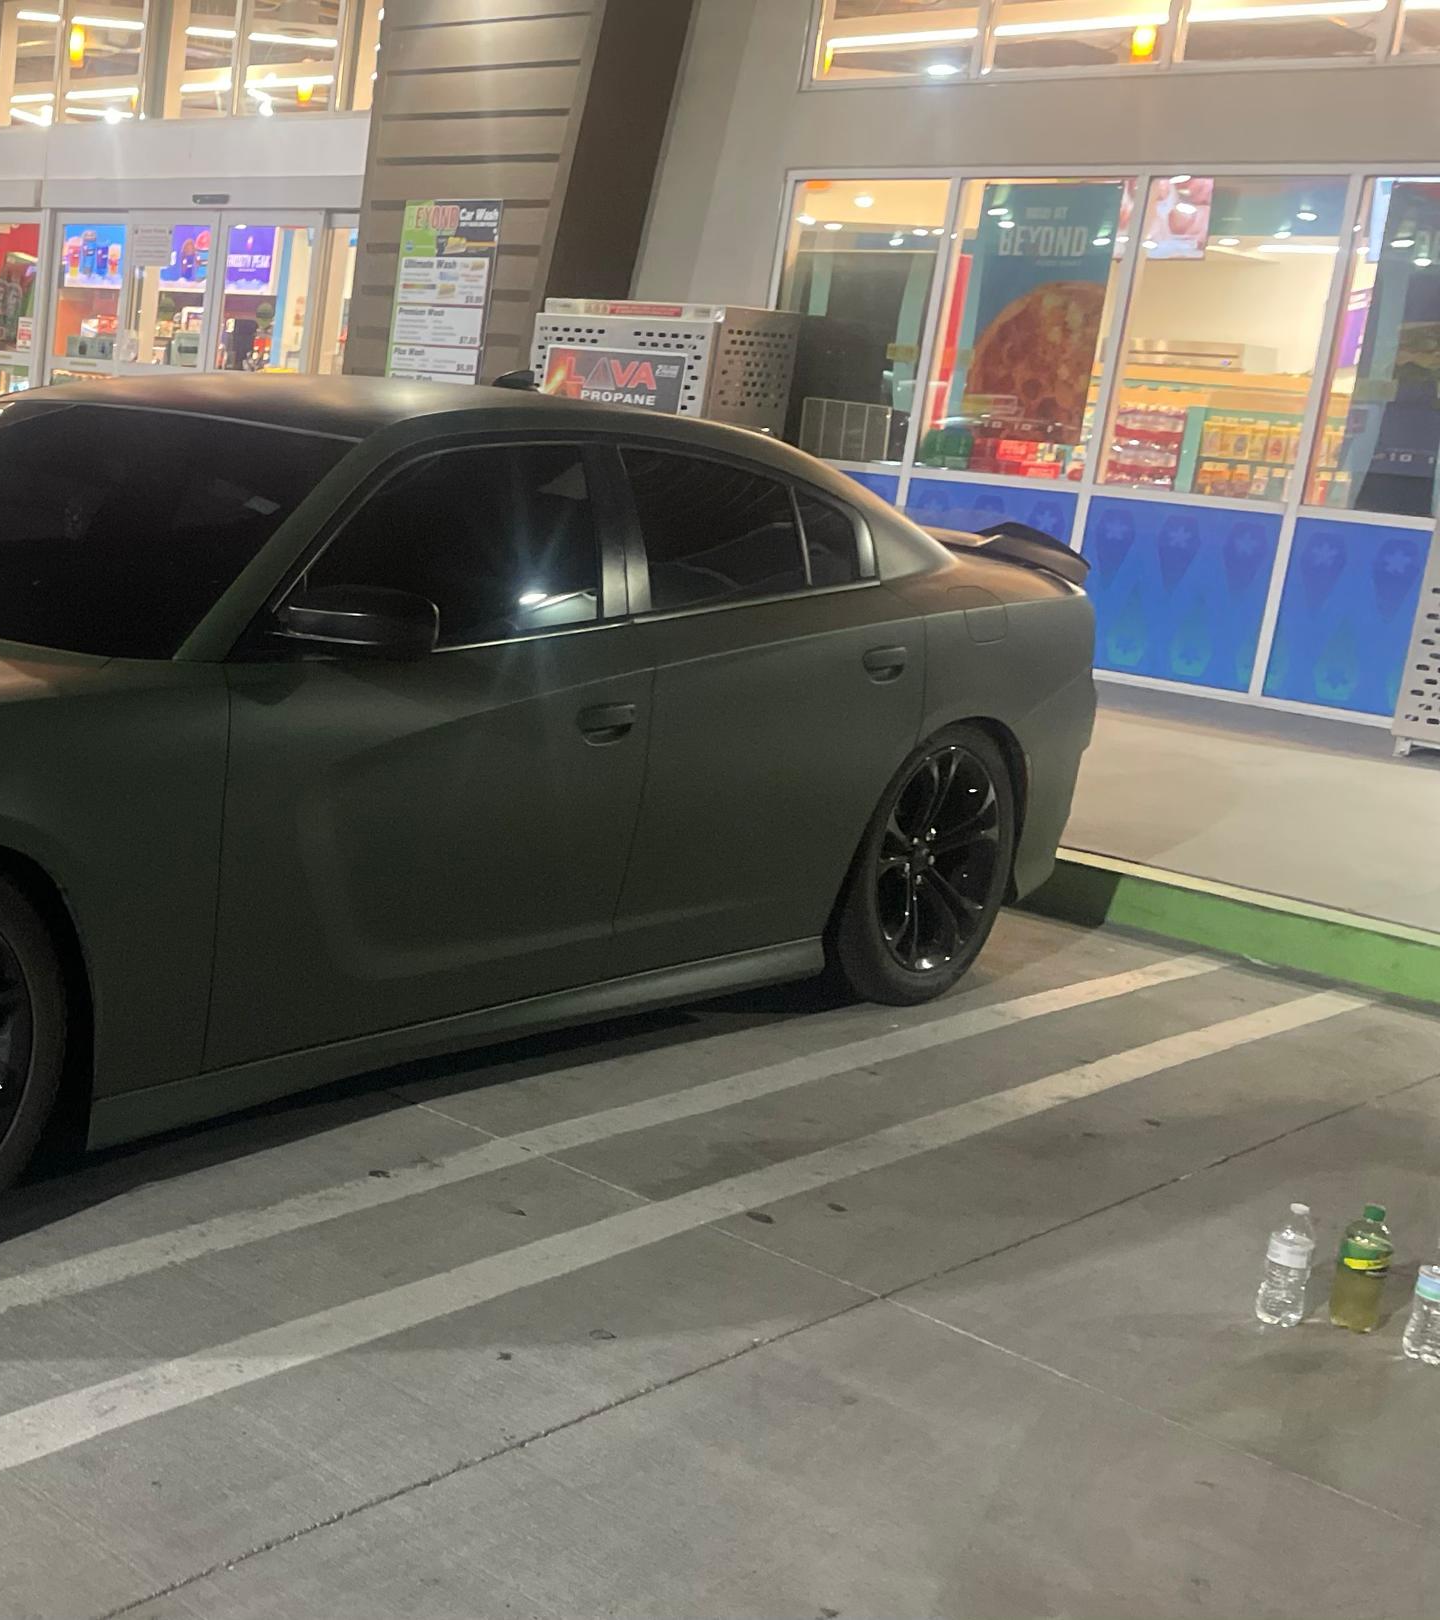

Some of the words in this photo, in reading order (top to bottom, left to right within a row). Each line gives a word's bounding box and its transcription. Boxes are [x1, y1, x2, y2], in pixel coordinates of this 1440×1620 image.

[460, 208, 475, 221] Car
[475, 207, 499, 221] Wash
[998, 226, 1088, 256] BEYOND
[436, 259, 458, 269] Wash
[427, 308, 445, 317] Wash
[407, 347, 425, 356] Wash
[567, 356, 657, 391] LAVA
[580, 390, 656, 406] PROPANE
